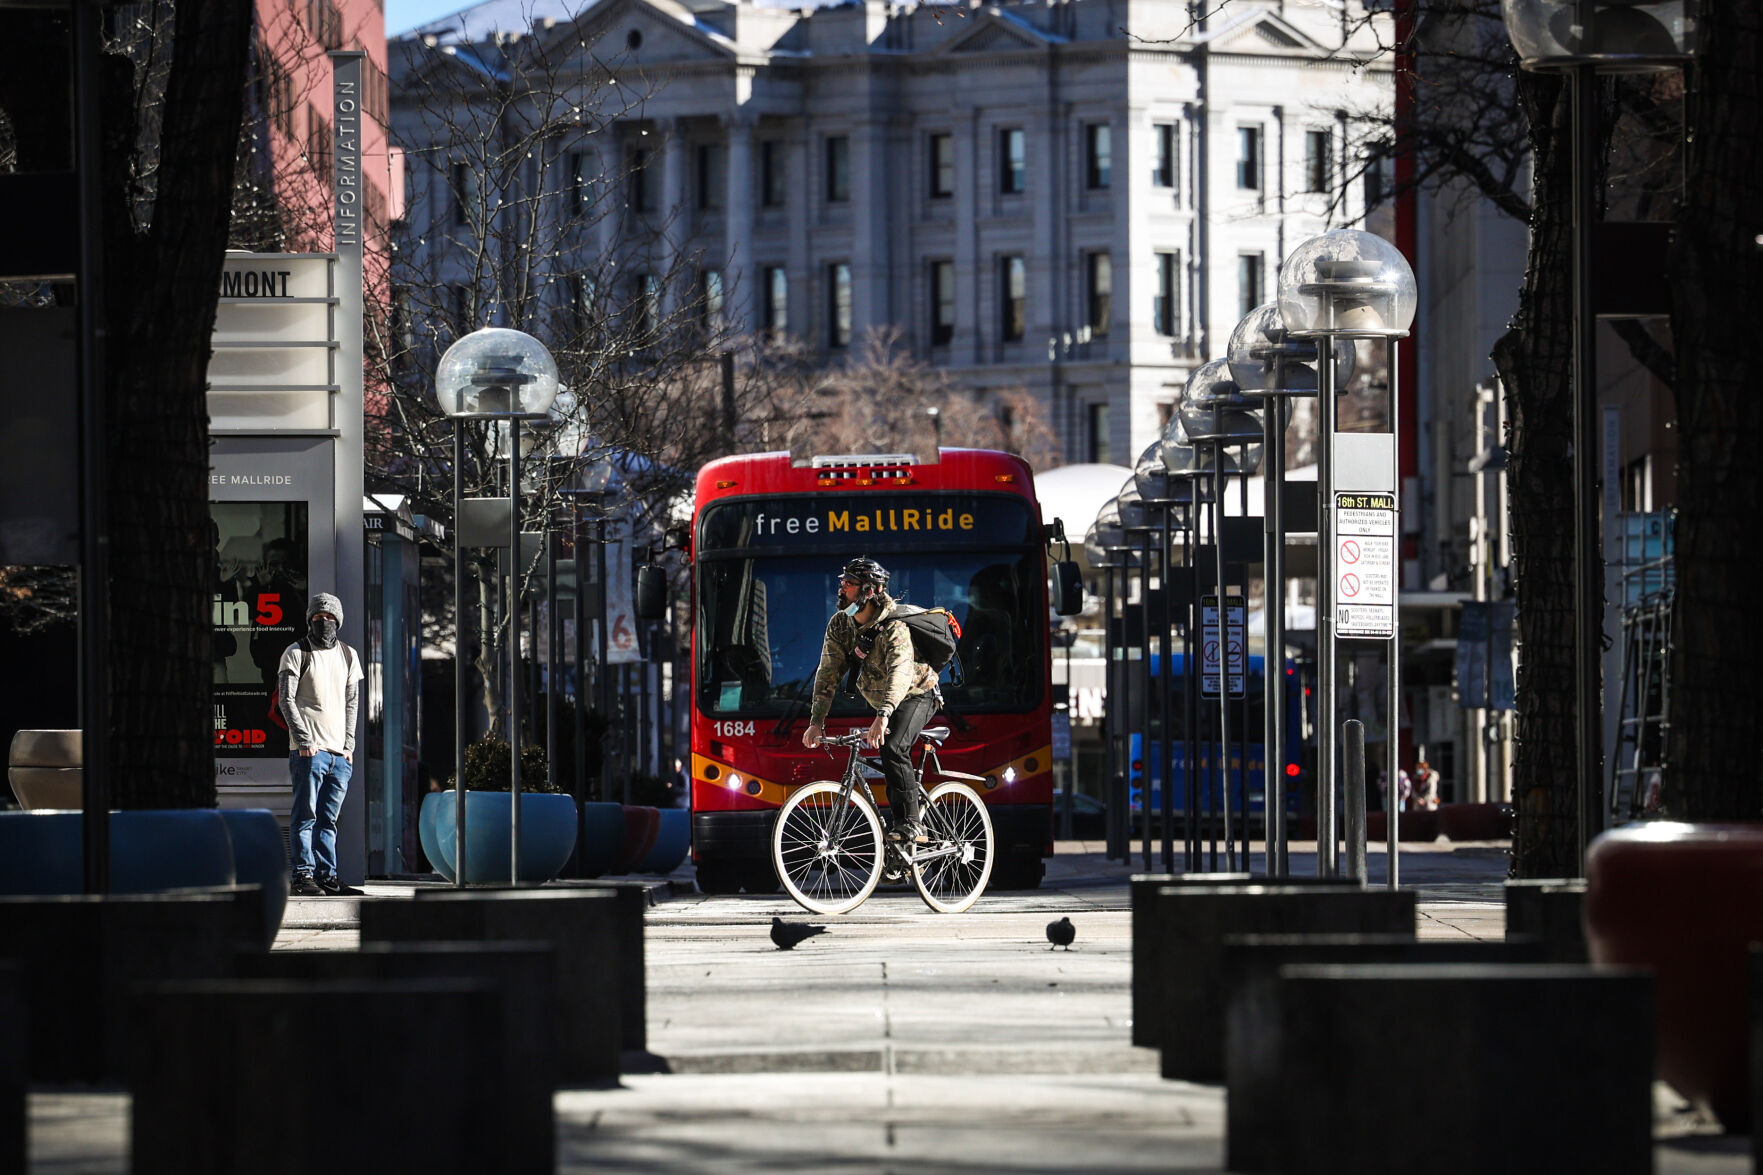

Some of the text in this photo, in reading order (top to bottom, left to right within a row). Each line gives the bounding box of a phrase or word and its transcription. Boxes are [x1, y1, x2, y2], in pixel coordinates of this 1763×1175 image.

[340, 81, 356, 244] INFORMATION
[223, 271, 291, 297] MONT
[208, 475, 292, 485] EE MALLRIDE
[1337, 496, 1392, 509] 16th ST. MALL
[755, 508, 975, 535] free MallRide
[212, 593, 283, 626] in 5
[1339, 609, 1350, 624] NO
[226, 625, 256, 633] experience
[269, 625, 295, 633] insecurity
[713, 720, 756, 737] 1684
[214, 729, 267, 745] VOID
